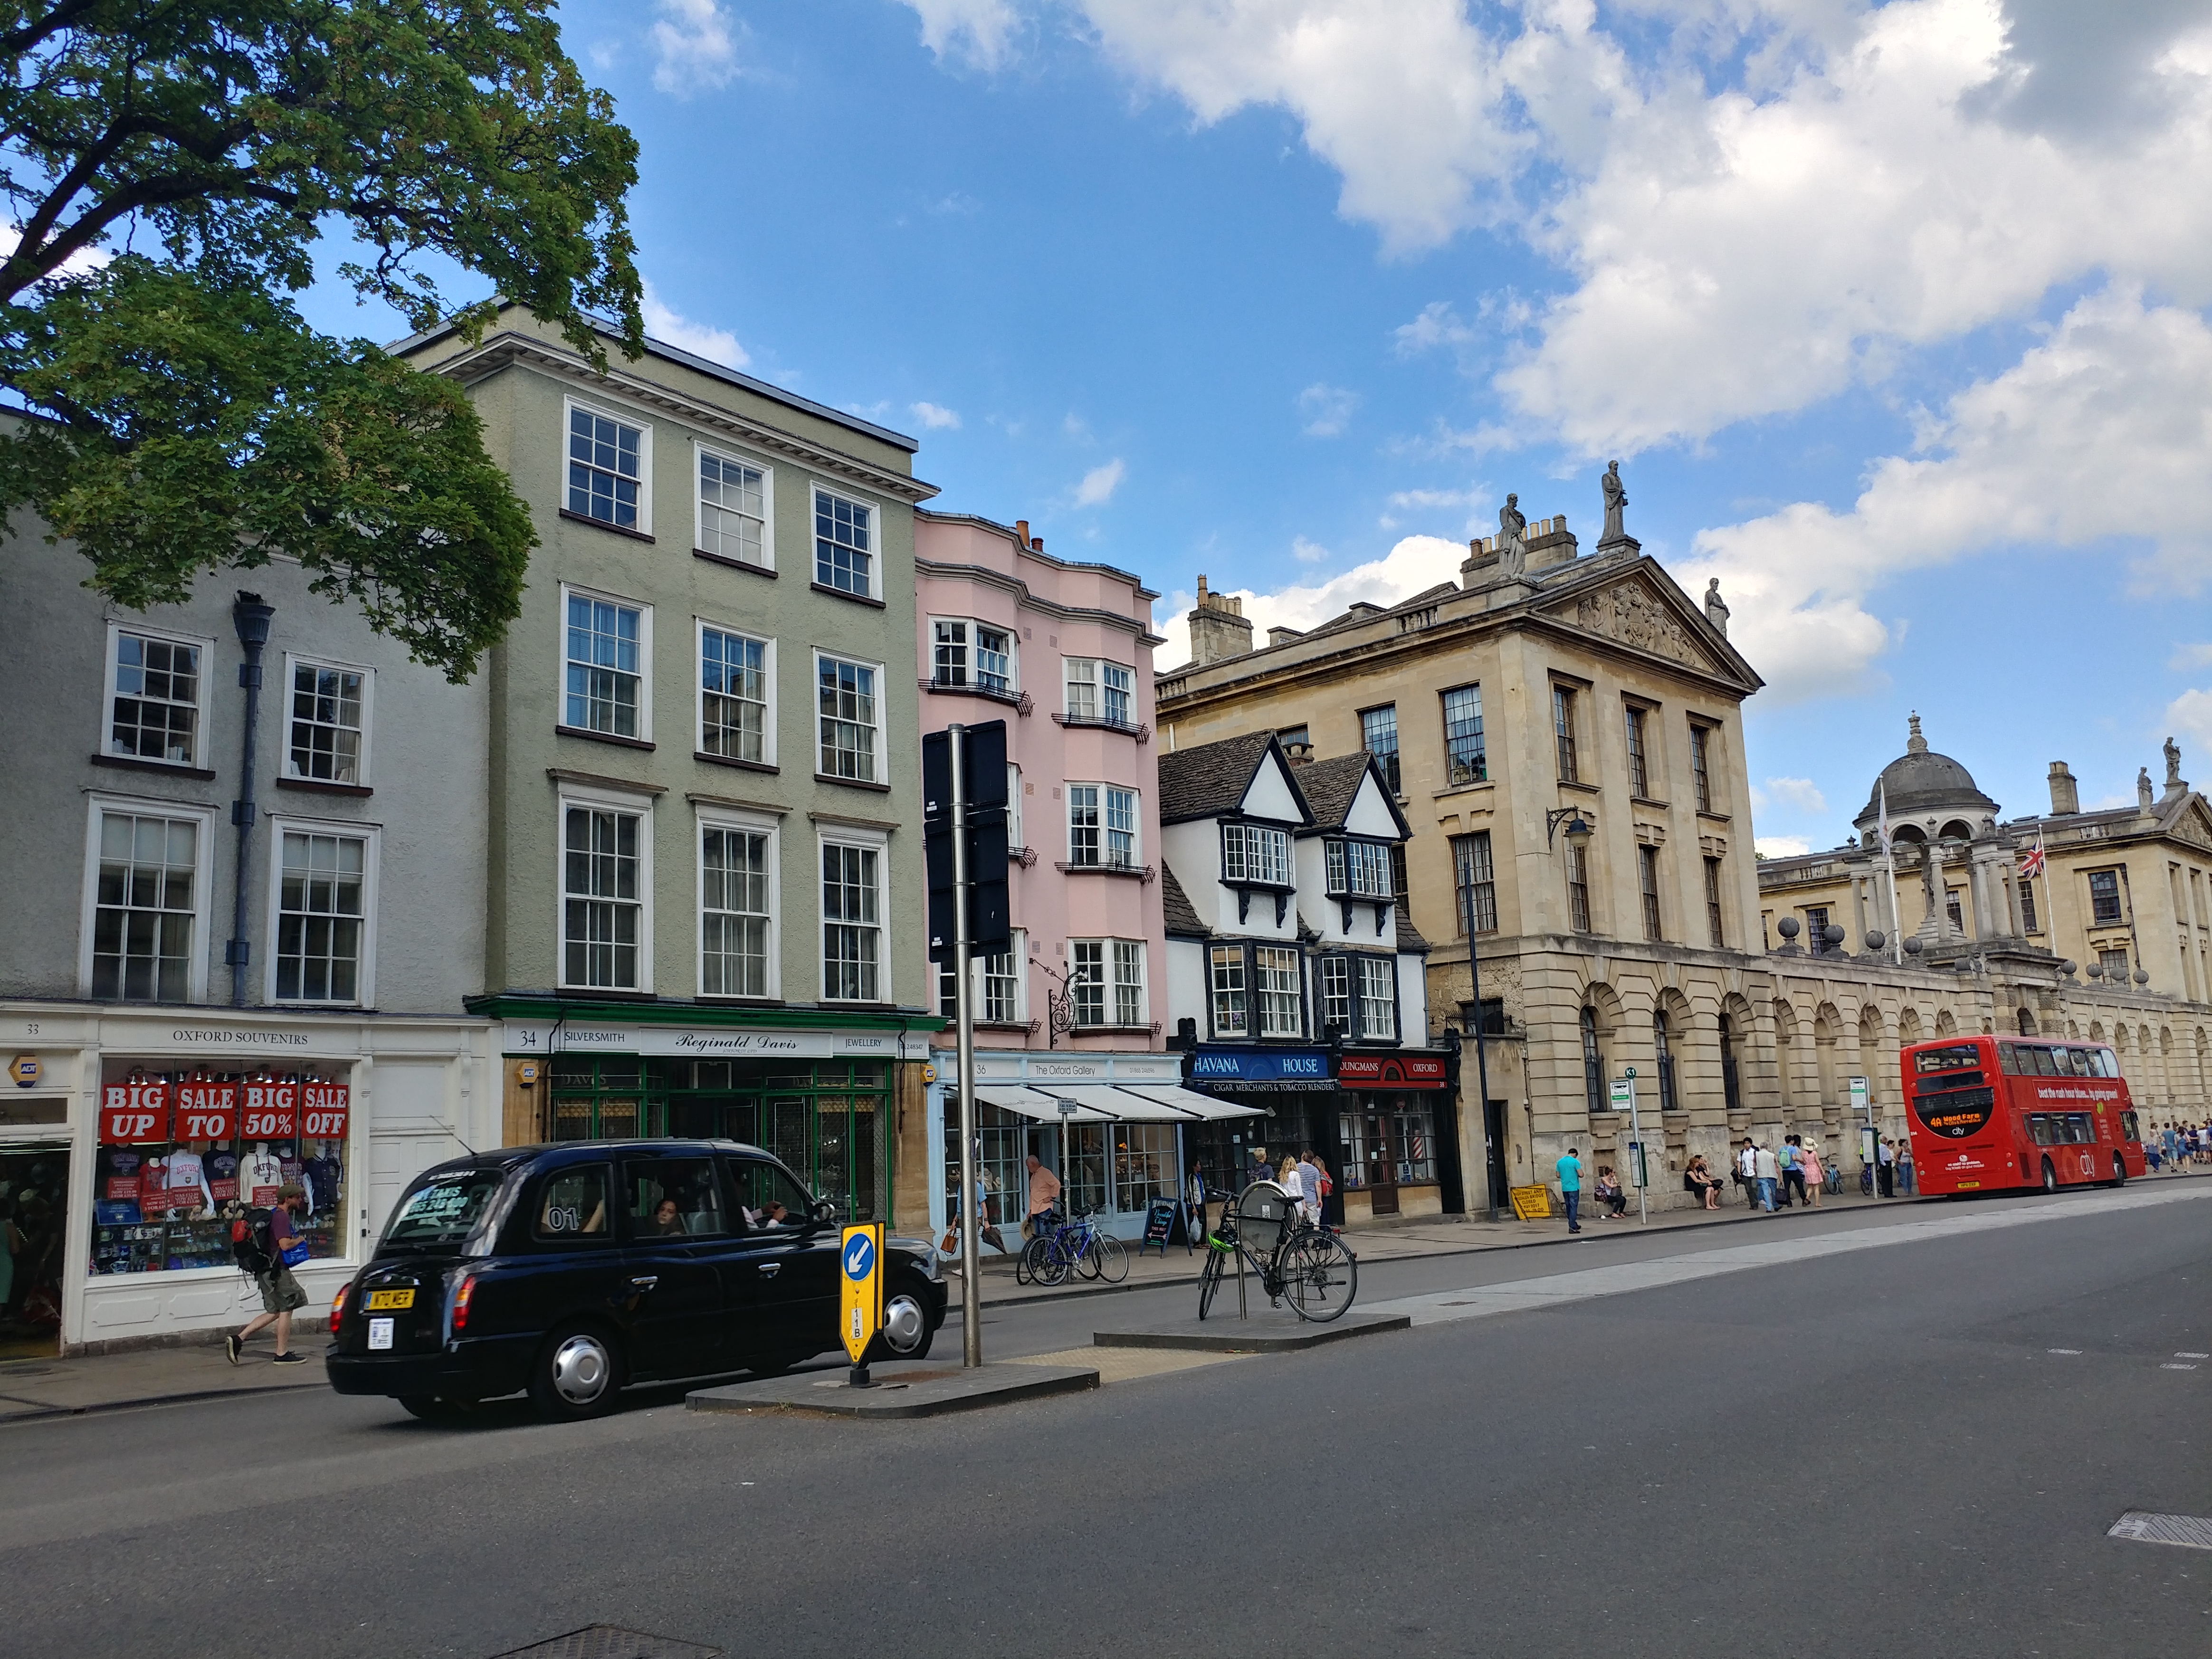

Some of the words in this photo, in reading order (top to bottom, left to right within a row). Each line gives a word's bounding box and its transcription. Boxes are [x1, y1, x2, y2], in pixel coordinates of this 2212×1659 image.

[28, 1024, 39, 1034] 33
[564, 1031, 625, 1042] SILVERSMITH
[173, 1030, 232, 1042] OXFORD
[236, 1032, 308, 1045] SOUVENIRS
[520, 1030, 536, 1046] 34
[676, 1033, 751, 1052] Reginald
[757, 1036, 800, 1049] Davis
[845, 1039, 882, 1049] JEWELLERY
[977, 1064, 986, 1074] 36
[1036, 1066, 1048, 1074] The
[1049, 1065, 1071, 1075] Oxford
[1073, 1066, 1096, 1077] Gallery
[1194, 1057, 1239, 1073] HAVANA
[1283, 1058, 1318, 1073] HOUSE
[1340, 1062, 1379, 1071] OUNGMANS
[1413, 1063, 1438, 1072] OXFORD
[563, 1074, 607, 1085] DAVS
[1214, 1083, 1234, 1091] CIGAR
[1236, 1083, 1273, 1092] MERCHANTS
[2038, 1087, 2049, 1098] beat
[2048, 1087, 2056, 1098] the
[2056, 1087, 2066, 1098] rush
[2064, 1087, 2075, 1098] hour
[2088, 1088, 2095, 1101] by
[2094, 1087, 2107, 1101] going
[105, 1087, 164, 1109] BIG
[180, 1088, 234, 1109] SALE
[246, 1087, 294, 1108] BIG
[305, 1087, 347, 1108] SALE
[112, 1115, 155, 1137] UP
[187, 1115, 226, 1137] TO
[245, 1114, 292, 1135] 50%
[306, 1112, 346, 1135] OFF
[1930, 1117, 1942, 1127] 4A
[1952, 1126, 1965, 1135] city
[253, 1163, 278, 1175] OXFORD
[2080, 1149, 2095, 1177] city
[547, 1207, 579, 1230] 01
